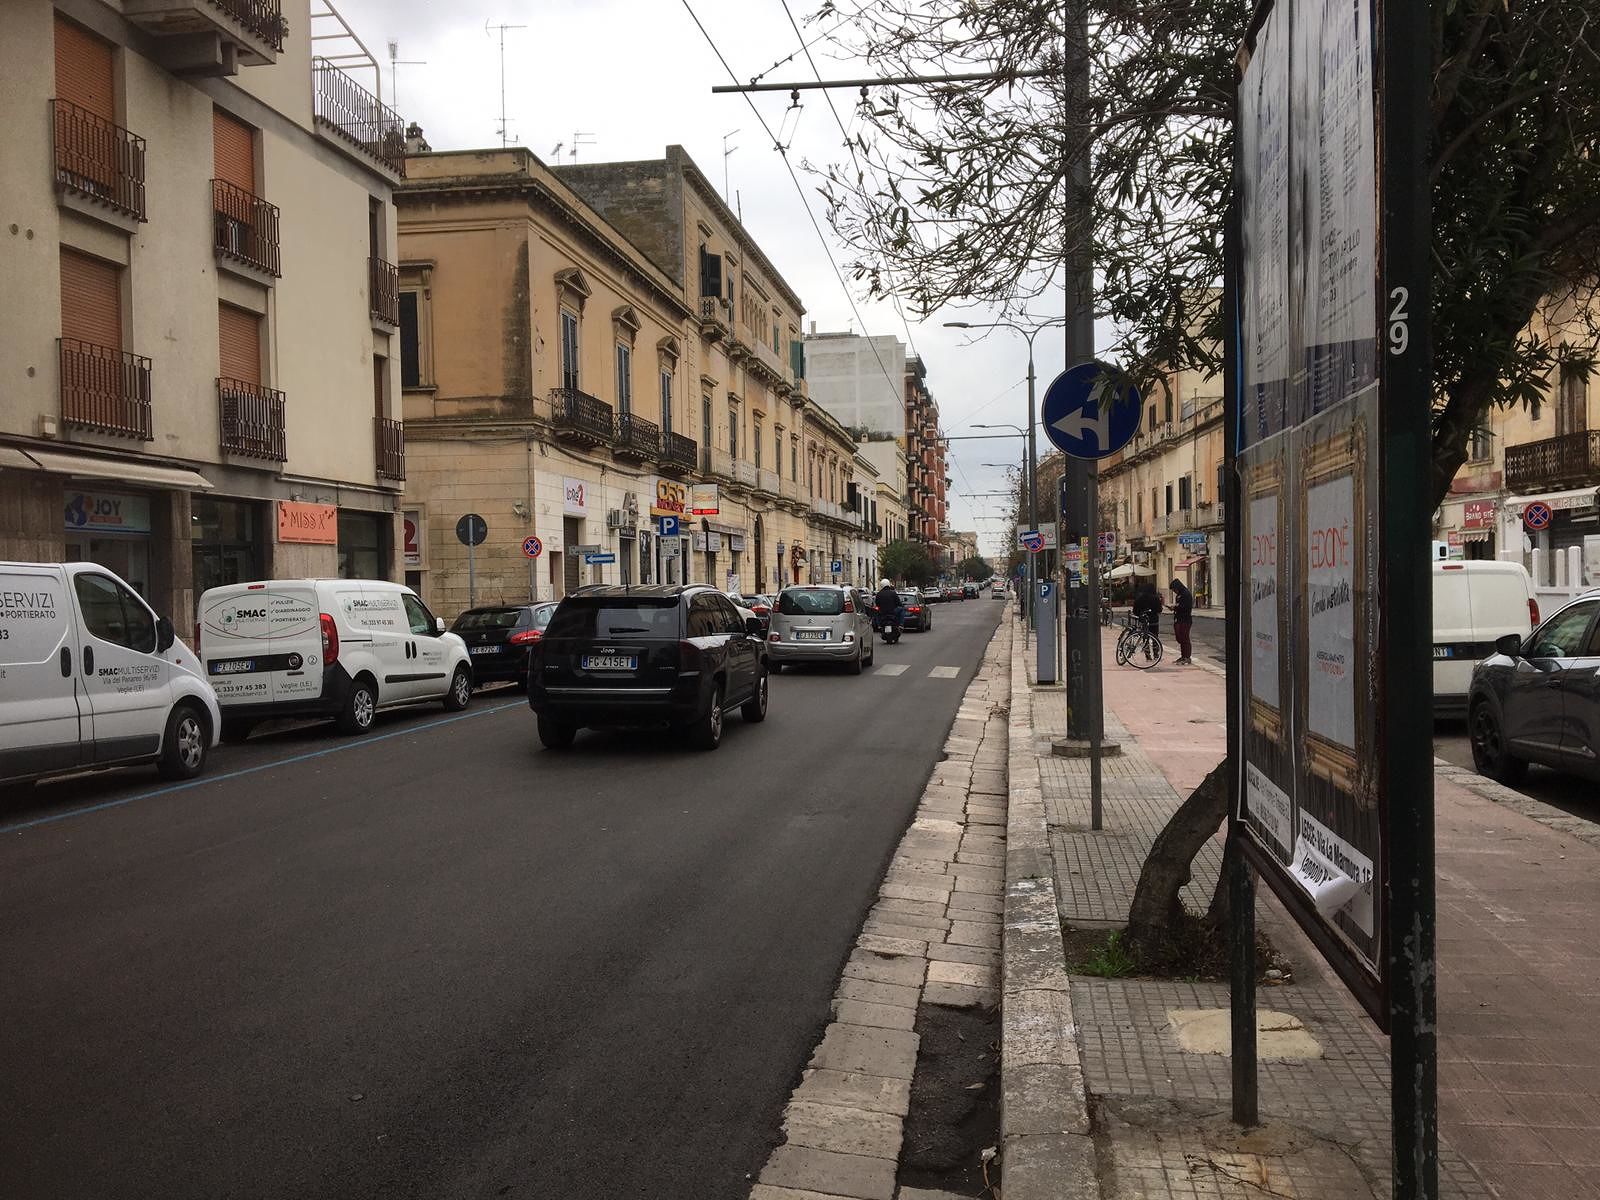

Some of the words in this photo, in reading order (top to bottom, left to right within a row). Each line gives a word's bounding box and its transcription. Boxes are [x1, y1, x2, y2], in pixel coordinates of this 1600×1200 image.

[95, 499, 121, 515] JOY
[290, 511, 317, 530] MISS
[663, 518, 675, 534] P
[832, 562, 840, 571] P
[1041, 585, 1048, 597] P
[5, 610, 56, 619] PORTIERATO
[236, 609, 267, 618] SMAC
